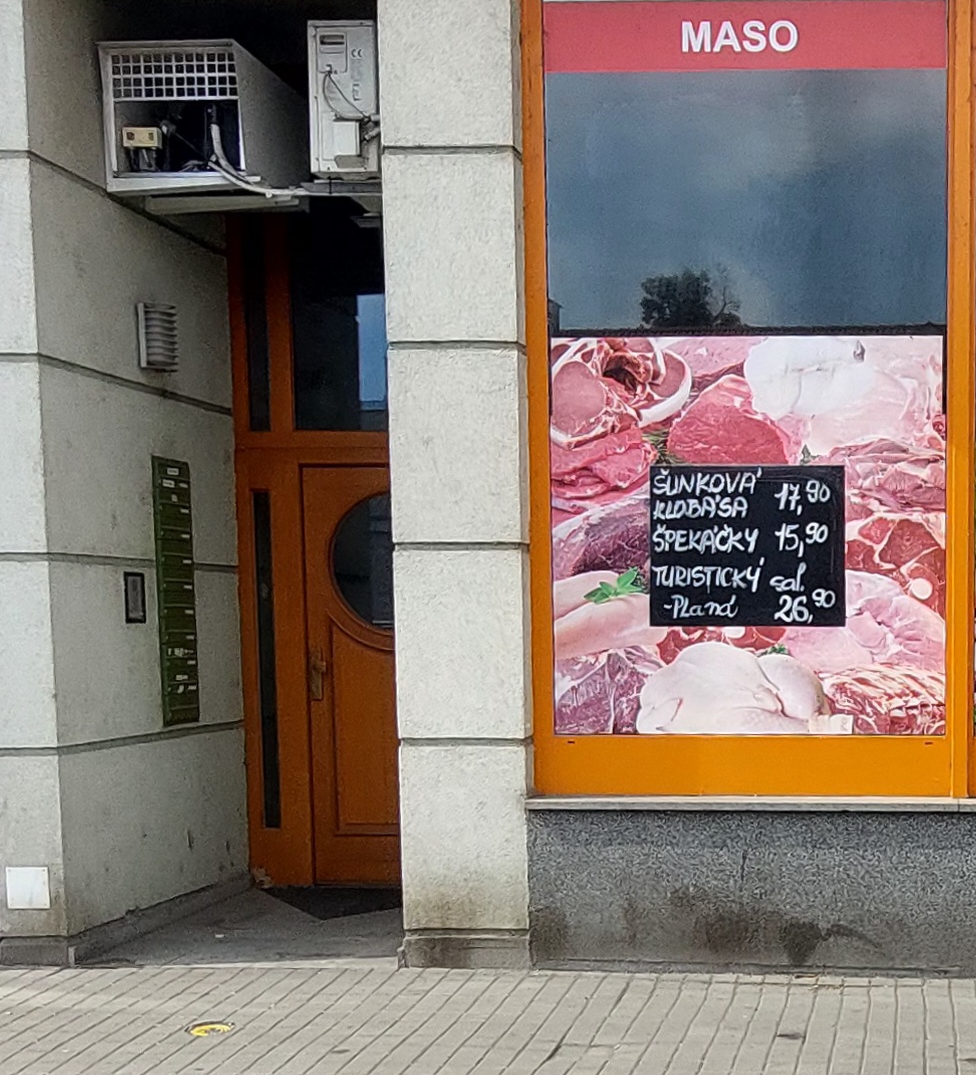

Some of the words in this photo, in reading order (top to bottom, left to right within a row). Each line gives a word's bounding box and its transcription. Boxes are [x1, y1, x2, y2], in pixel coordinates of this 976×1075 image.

[680, 20, 799, 53] MASO
[653, 468, 762, 496] ŠUNKOVÁ
[653, 496, 748, 520] KLOBÁSA
[652, 524, 759, 554] ŠPEKÁČKY
[652, 557, 765, 594] TURISTICKÝ
